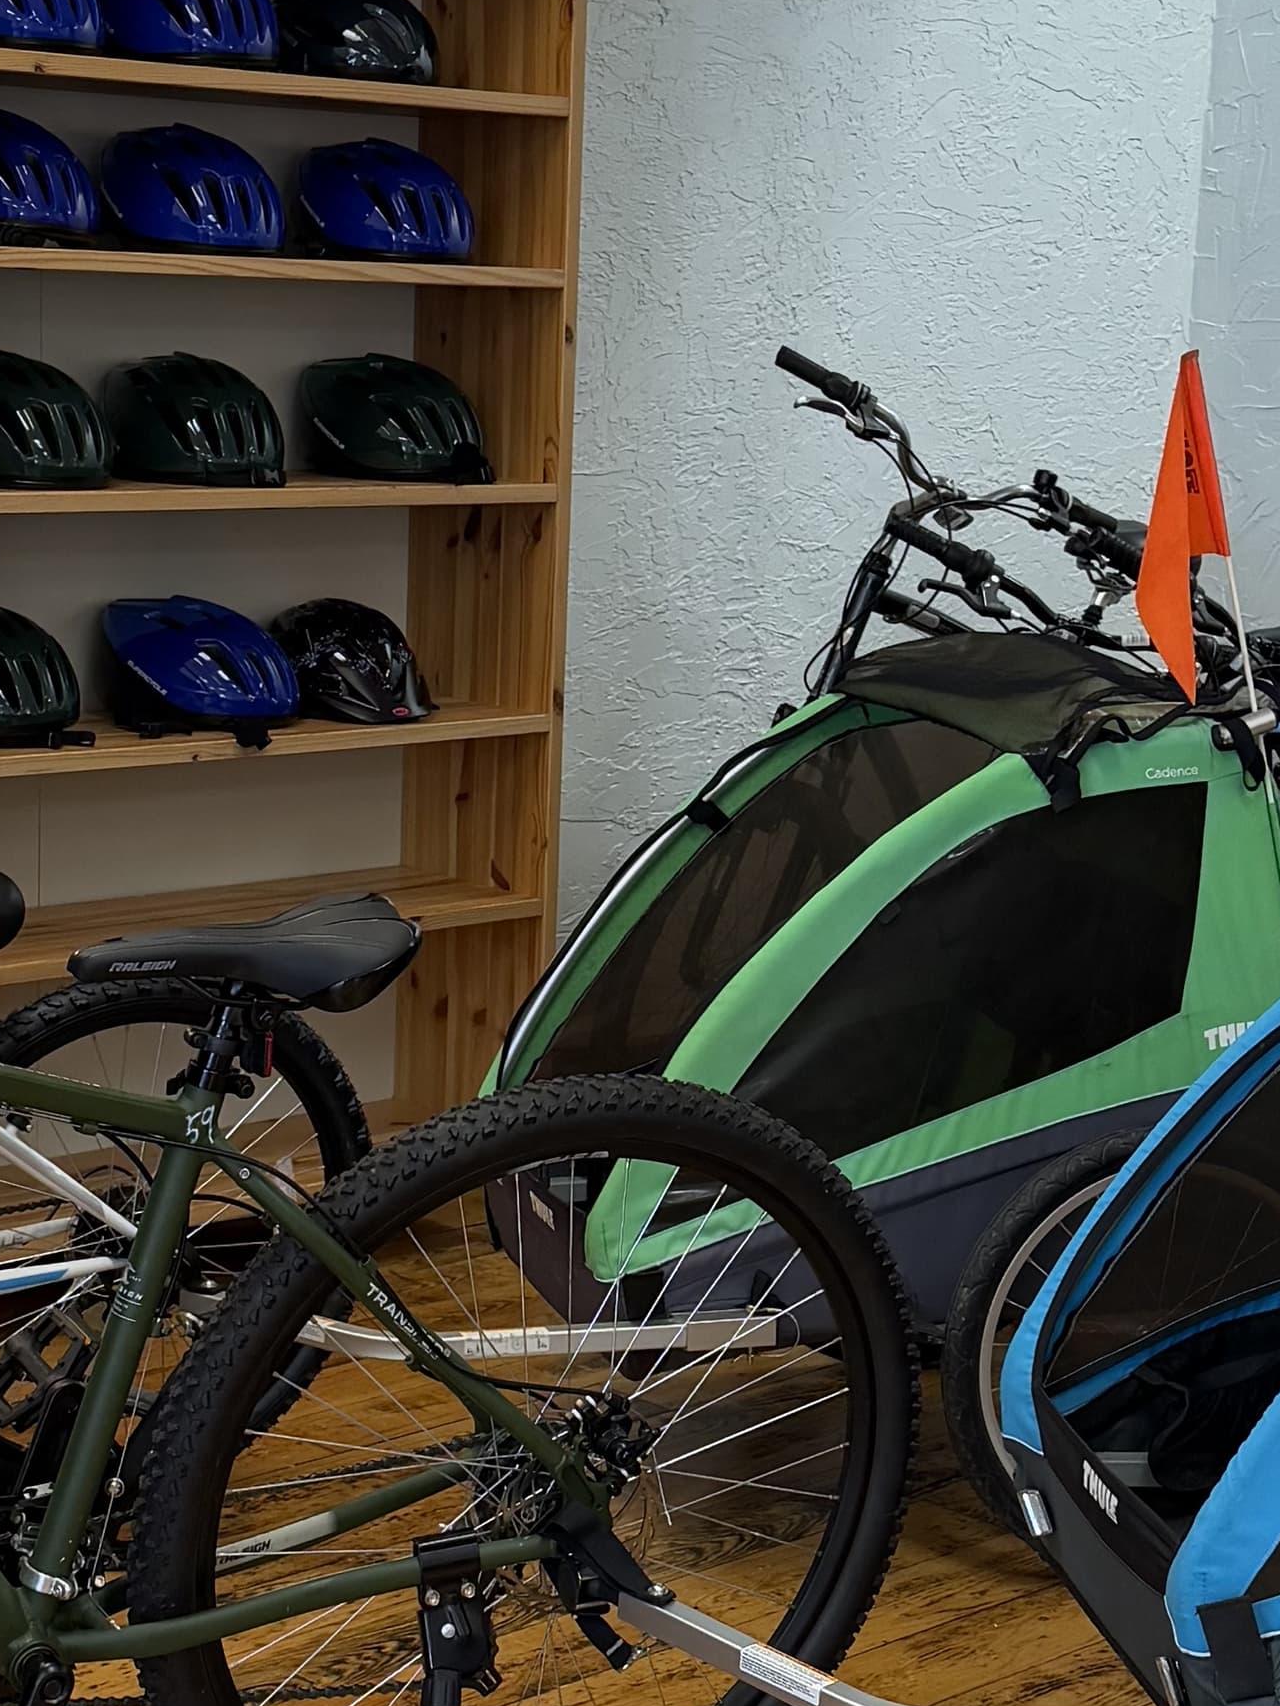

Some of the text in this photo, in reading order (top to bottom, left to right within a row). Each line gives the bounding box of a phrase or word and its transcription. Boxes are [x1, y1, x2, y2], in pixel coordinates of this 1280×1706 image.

[1145, 766, 1199, 780] Cadence
[108, 959, 177, 973] RALEIGH
[185, 1104, 216, 1144] 59
[1083, 1459, 1119, 1525] THULE
